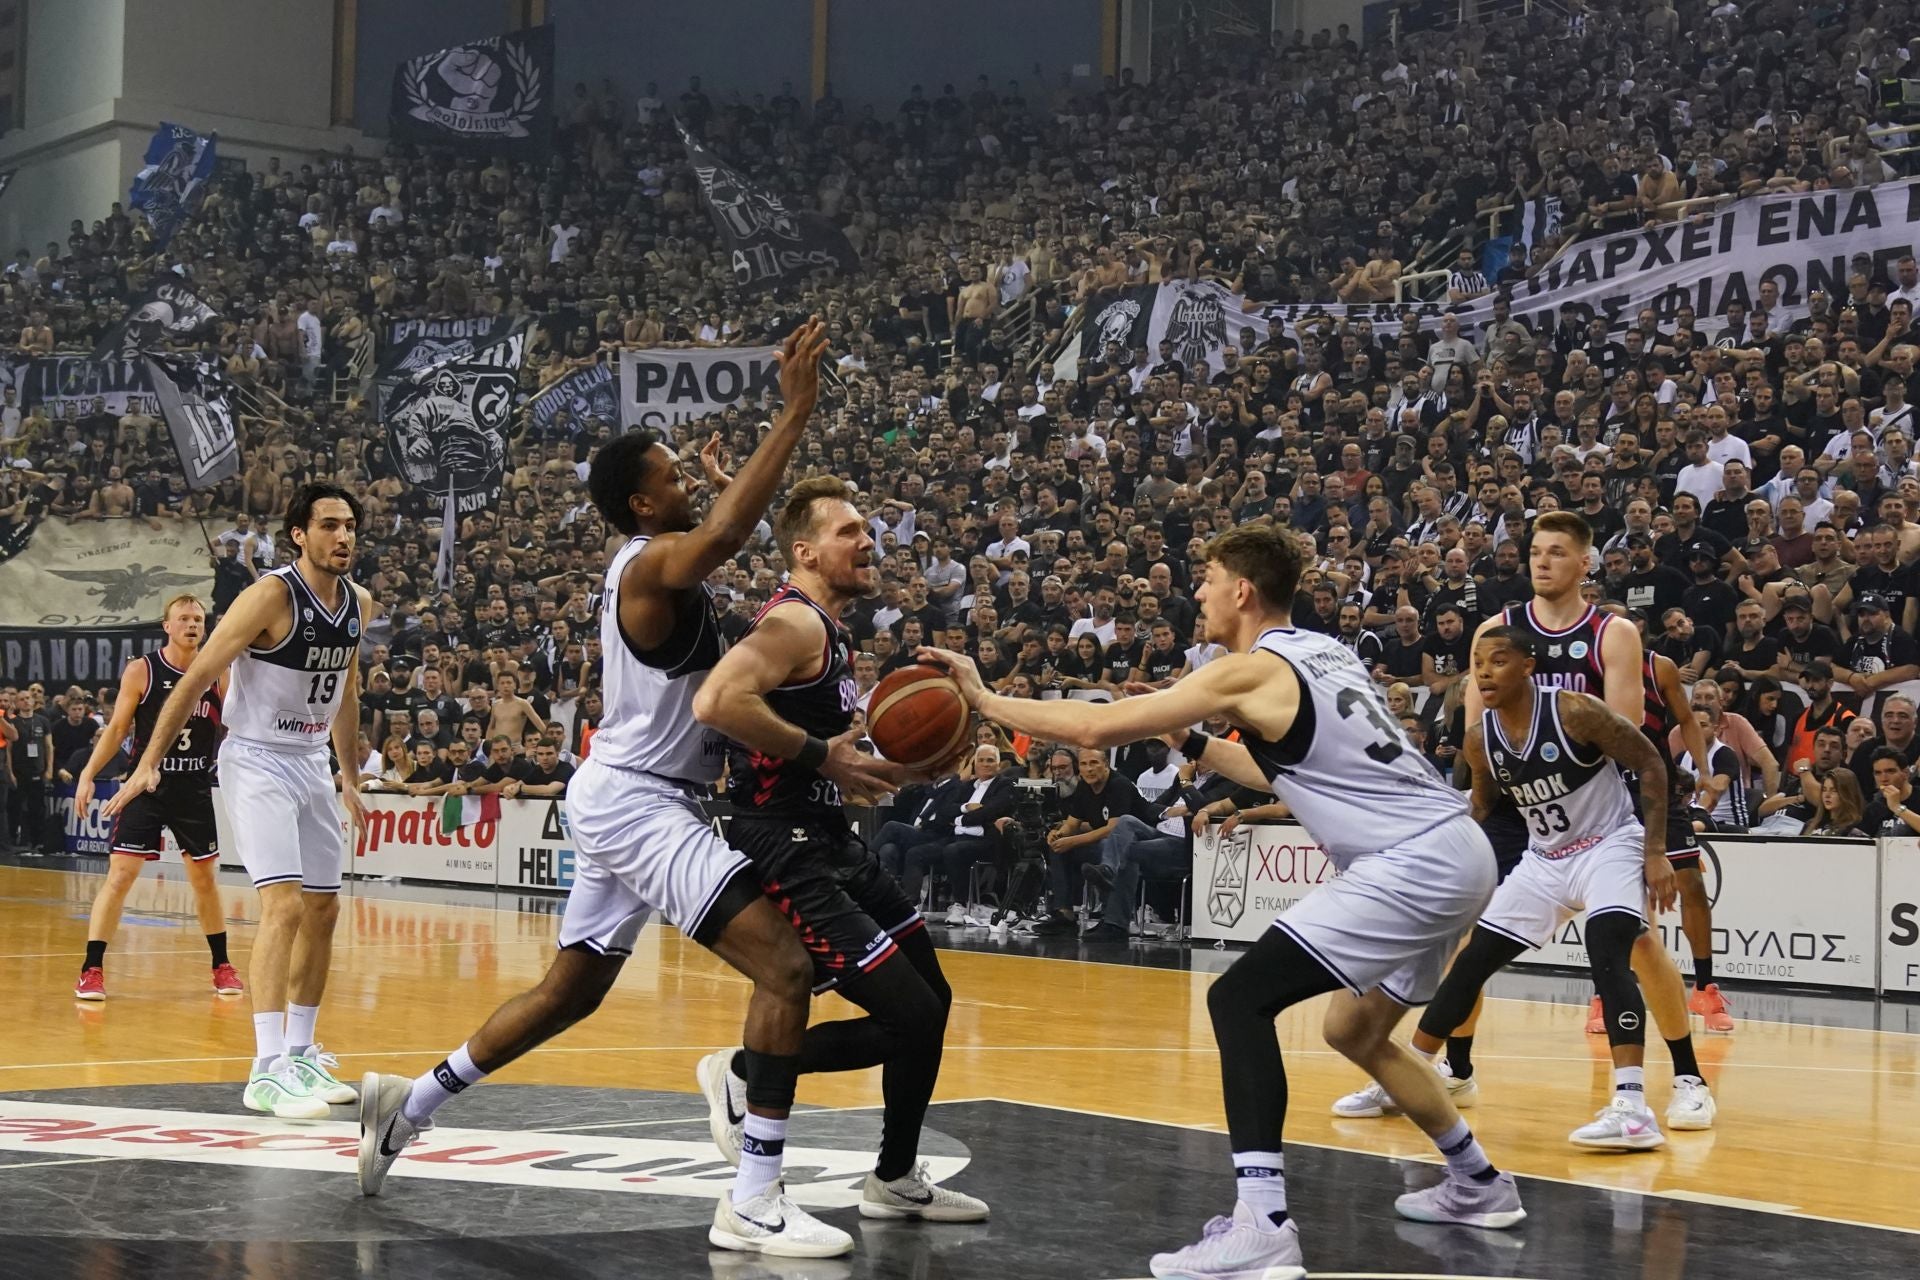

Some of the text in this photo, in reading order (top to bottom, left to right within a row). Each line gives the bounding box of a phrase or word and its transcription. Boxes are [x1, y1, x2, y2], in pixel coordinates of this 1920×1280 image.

[1757, 189, 1881, 246] ΕΝΑ
[307, 673, 338, 705] 19
[177, 728, 192, 751] 3
[163, 755, 207, 771] urne
[1511, 773, 1570, 806] PAOK
[1529, 803, 1571, 836] 33
[77, 839, 88, 851] CAR
[446, 859, 493, 871] AIMING HIGH
[519, 847, 576, 887] HELE
[1725, 962, 1795, 977] ΦΩΤΙΣΜΟΣ
